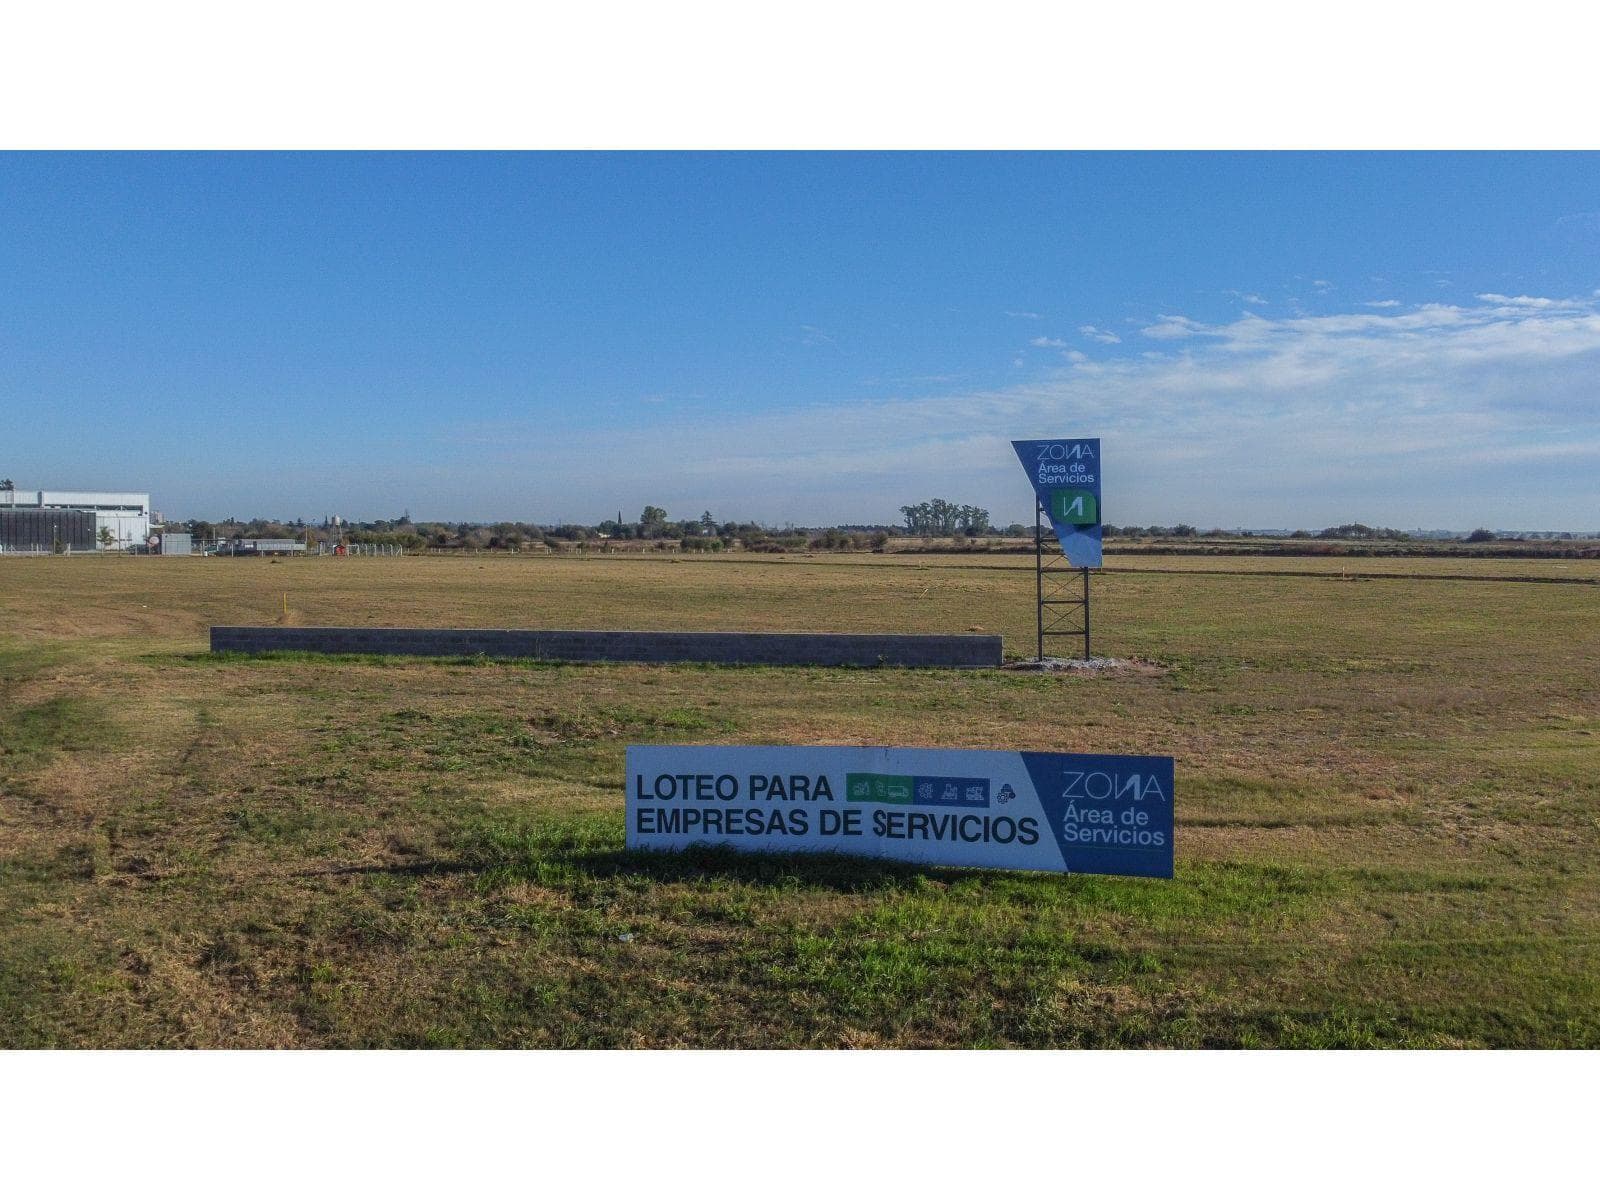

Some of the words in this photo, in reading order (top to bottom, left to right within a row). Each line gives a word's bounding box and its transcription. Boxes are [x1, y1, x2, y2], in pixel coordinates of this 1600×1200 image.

[1038, 460, 1066, 473] Área
[1070, 462, 1086, 473] de
[1038, 473, 1095, 484] Servicios
[636, 774, 739, 801] LOTEO
[750, 775, 834, 801] PARA
[1062, 771, 1165, 801] ZONA
[1063, 801, 1113, 825] Área
[1121, 807, 1149, 826] de
[636, 808, 809, 836] EMPRESAS
[819, 809, 863, 836] DE
[872, 809, 1039, 846] SERVICIOS
[1063, 823, 1165, 846] Servicios
